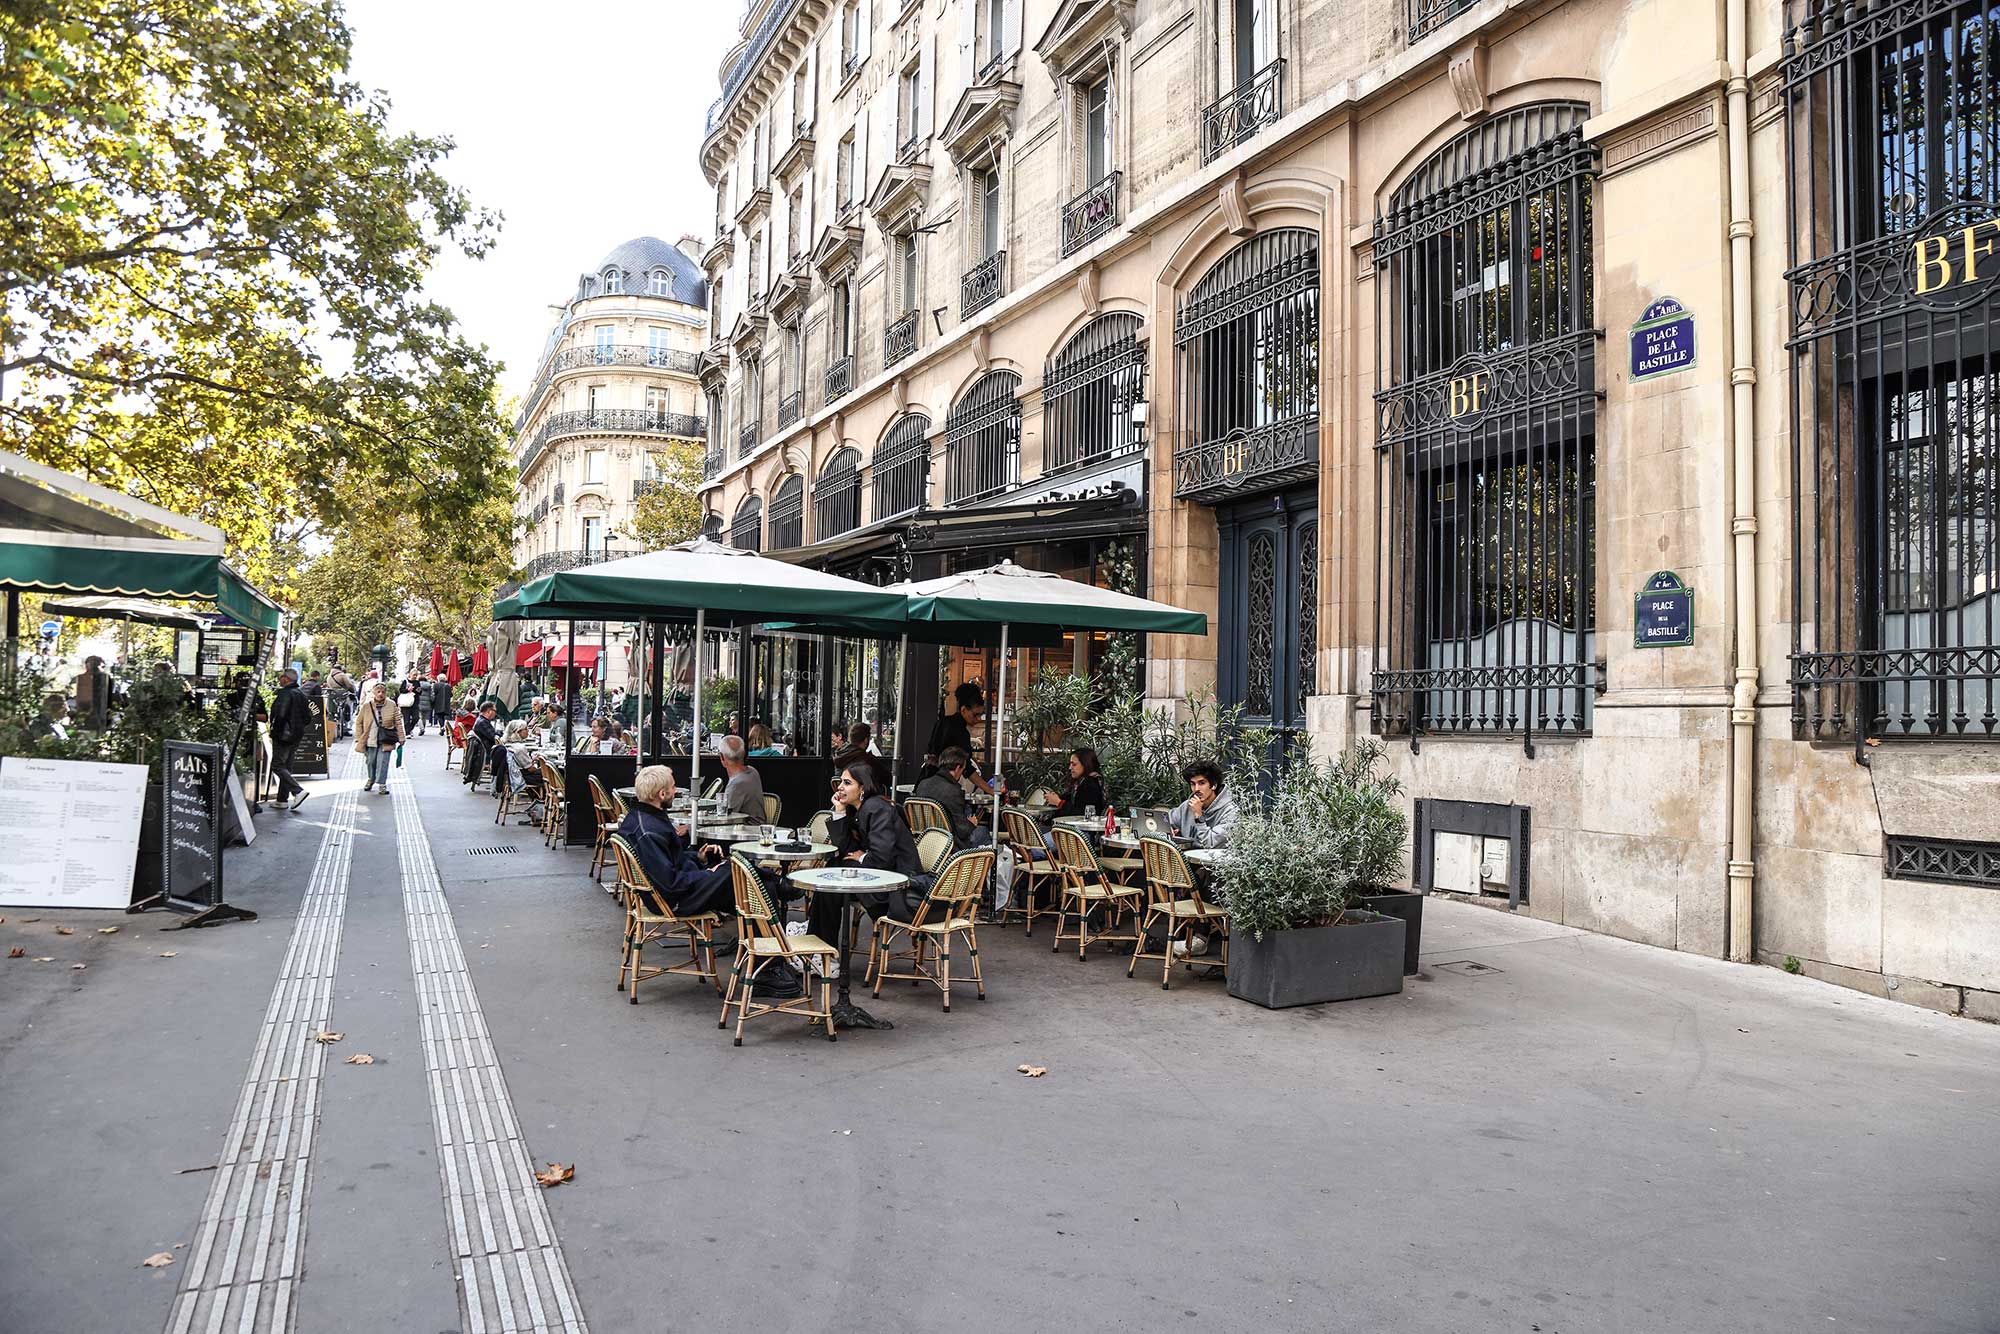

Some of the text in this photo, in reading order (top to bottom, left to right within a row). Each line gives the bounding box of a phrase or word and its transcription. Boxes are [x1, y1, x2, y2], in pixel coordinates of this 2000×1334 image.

[1914, 218, 2000, 295] BF
[1646, 326, 1679, 344] PLACE
[1648, 340, 1677, 356] DE LA
[1639, 350, 1687, 371] BASTILLE
[1449, 370, 1490, 418] BF
[1223, 440, 1249, 476] BF
[1273, 496, 1280, 510] 7
[1652, 601, 1674, 611] PLACE
[1647, 627, 1679, 636] BASTILLE
